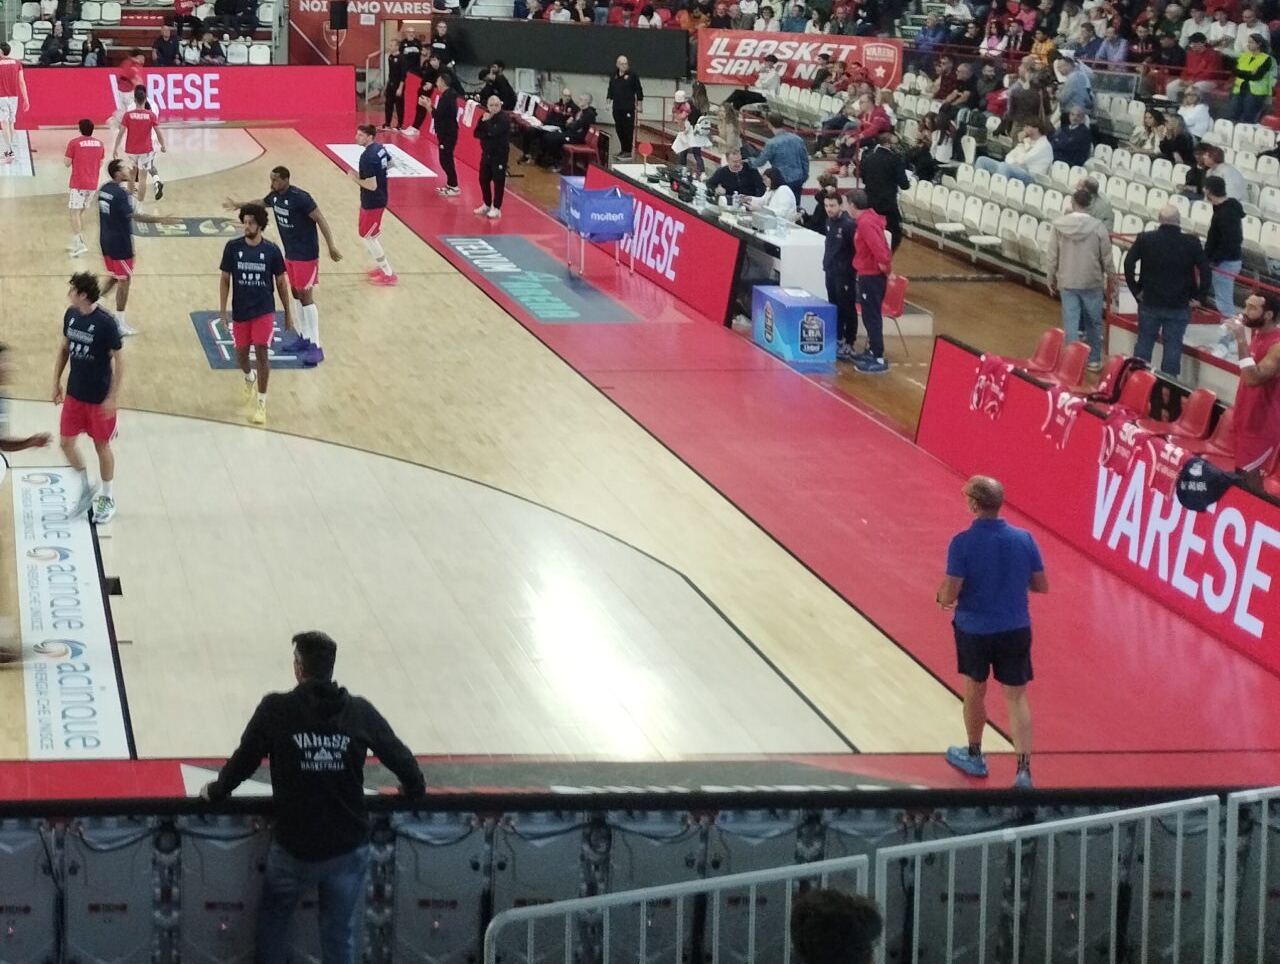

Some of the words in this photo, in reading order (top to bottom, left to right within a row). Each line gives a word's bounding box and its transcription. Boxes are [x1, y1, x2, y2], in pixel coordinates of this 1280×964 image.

[300, 0, 328, 12] NOI
[347, 1, 380, 13] AMO
[383, 1, 432, 14] VARES
[707, 38, 731, 56] IL
[734, 39, 857, 62] BASKET
[590, 212, 624, 222] molten
[446, 237, 522, 273] ITELYUM
[803, 329, 822, 338] LBA
[38, 486, 76, 539] acinque
[1091, 460, 1280, 639] VARESE
[47, 563, 90, 632] acinque
[56, 661, 106, 750] acinque
[293, 732, 350, 751] VARESE
